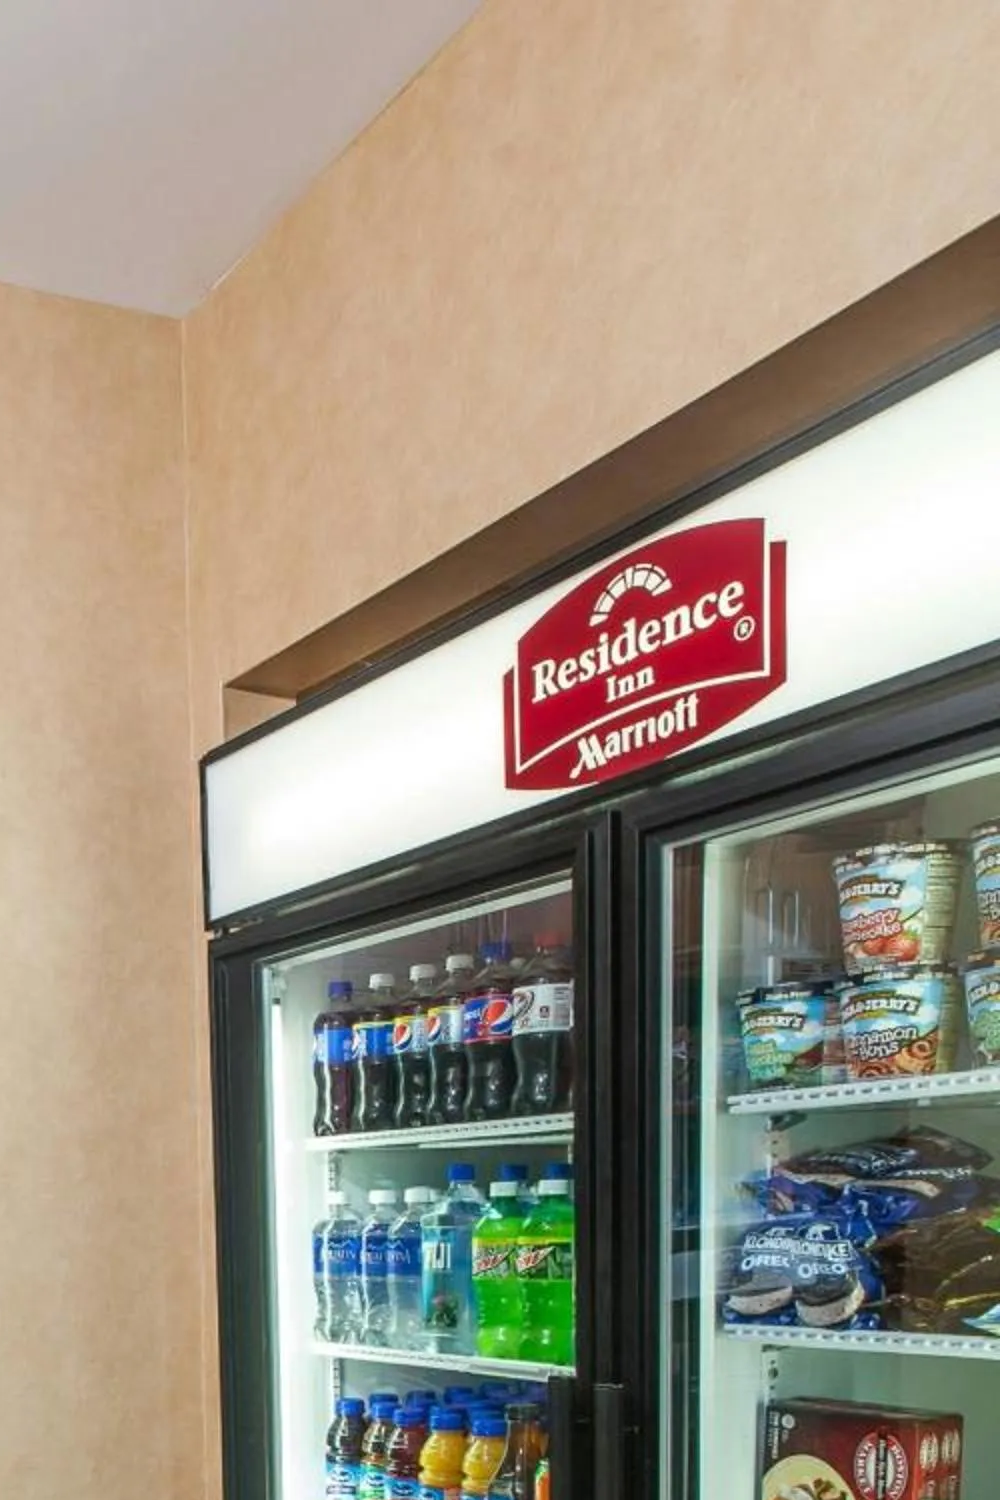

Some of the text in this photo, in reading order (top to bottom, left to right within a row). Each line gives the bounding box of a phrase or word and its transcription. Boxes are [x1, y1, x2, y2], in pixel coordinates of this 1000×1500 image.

[531, 580, 745, 704] Residence
[606, 666, 656, 702] Inn
[569, 692, 699, 779] Marriott
